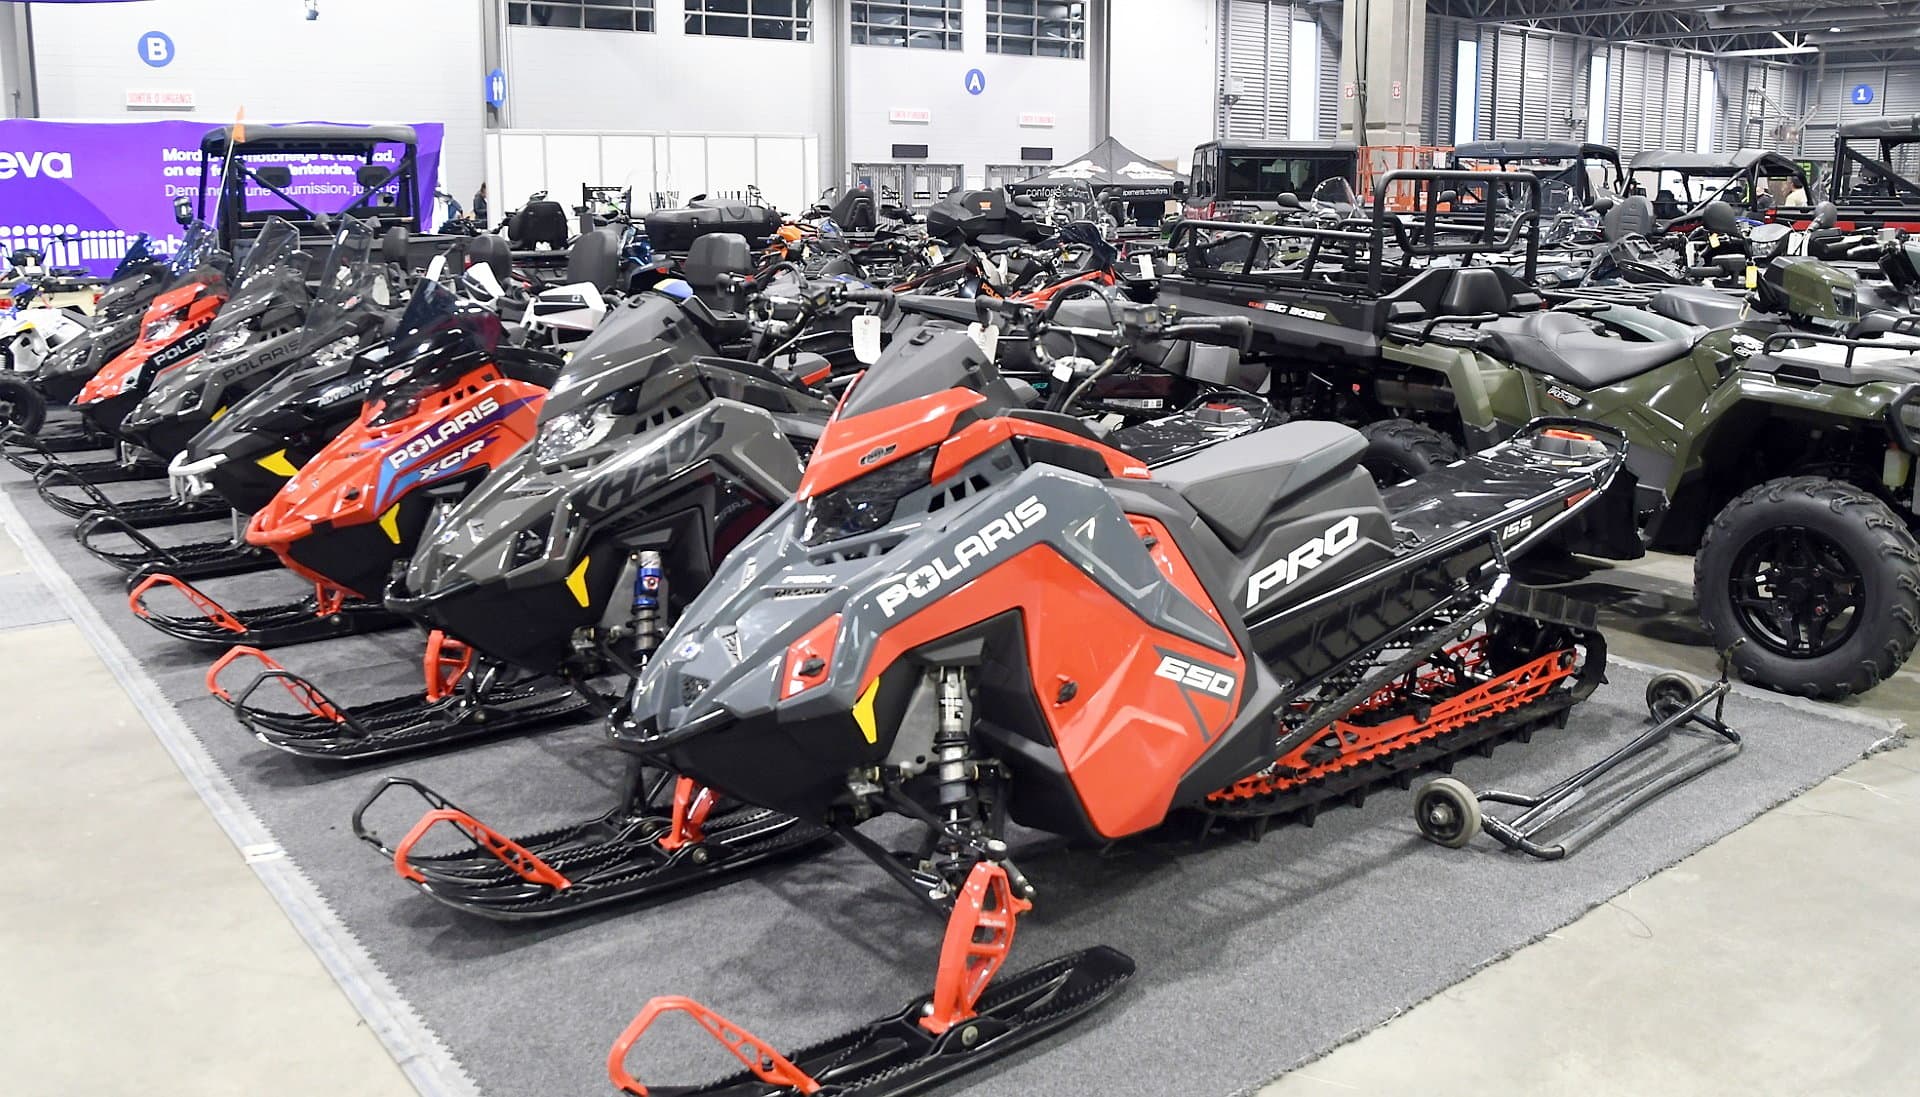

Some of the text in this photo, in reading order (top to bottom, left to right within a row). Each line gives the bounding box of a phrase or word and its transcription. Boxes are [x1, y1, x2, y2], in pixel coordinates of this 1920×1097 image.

[146, 37, 168, 61] B
[968, 73, 982, 91] A
[1857, 88, 1866, 101] 1
[163, 166, 181, 176] on
[1265, 302, 1288, 313] BIG
[1289, 306, 1326, 320] BOSS
[153, 331, 210, 366] POLAR
[388, 397, 500, 470] POLARIS
[420, 439, 485, 482] XCR
[1502, 514, 1533, 541] 155
[875, 495, 1047, 619] POLARIS
[1246, 515, 1359, 609] PRO
[1154, 655, 1236, 697] 650
